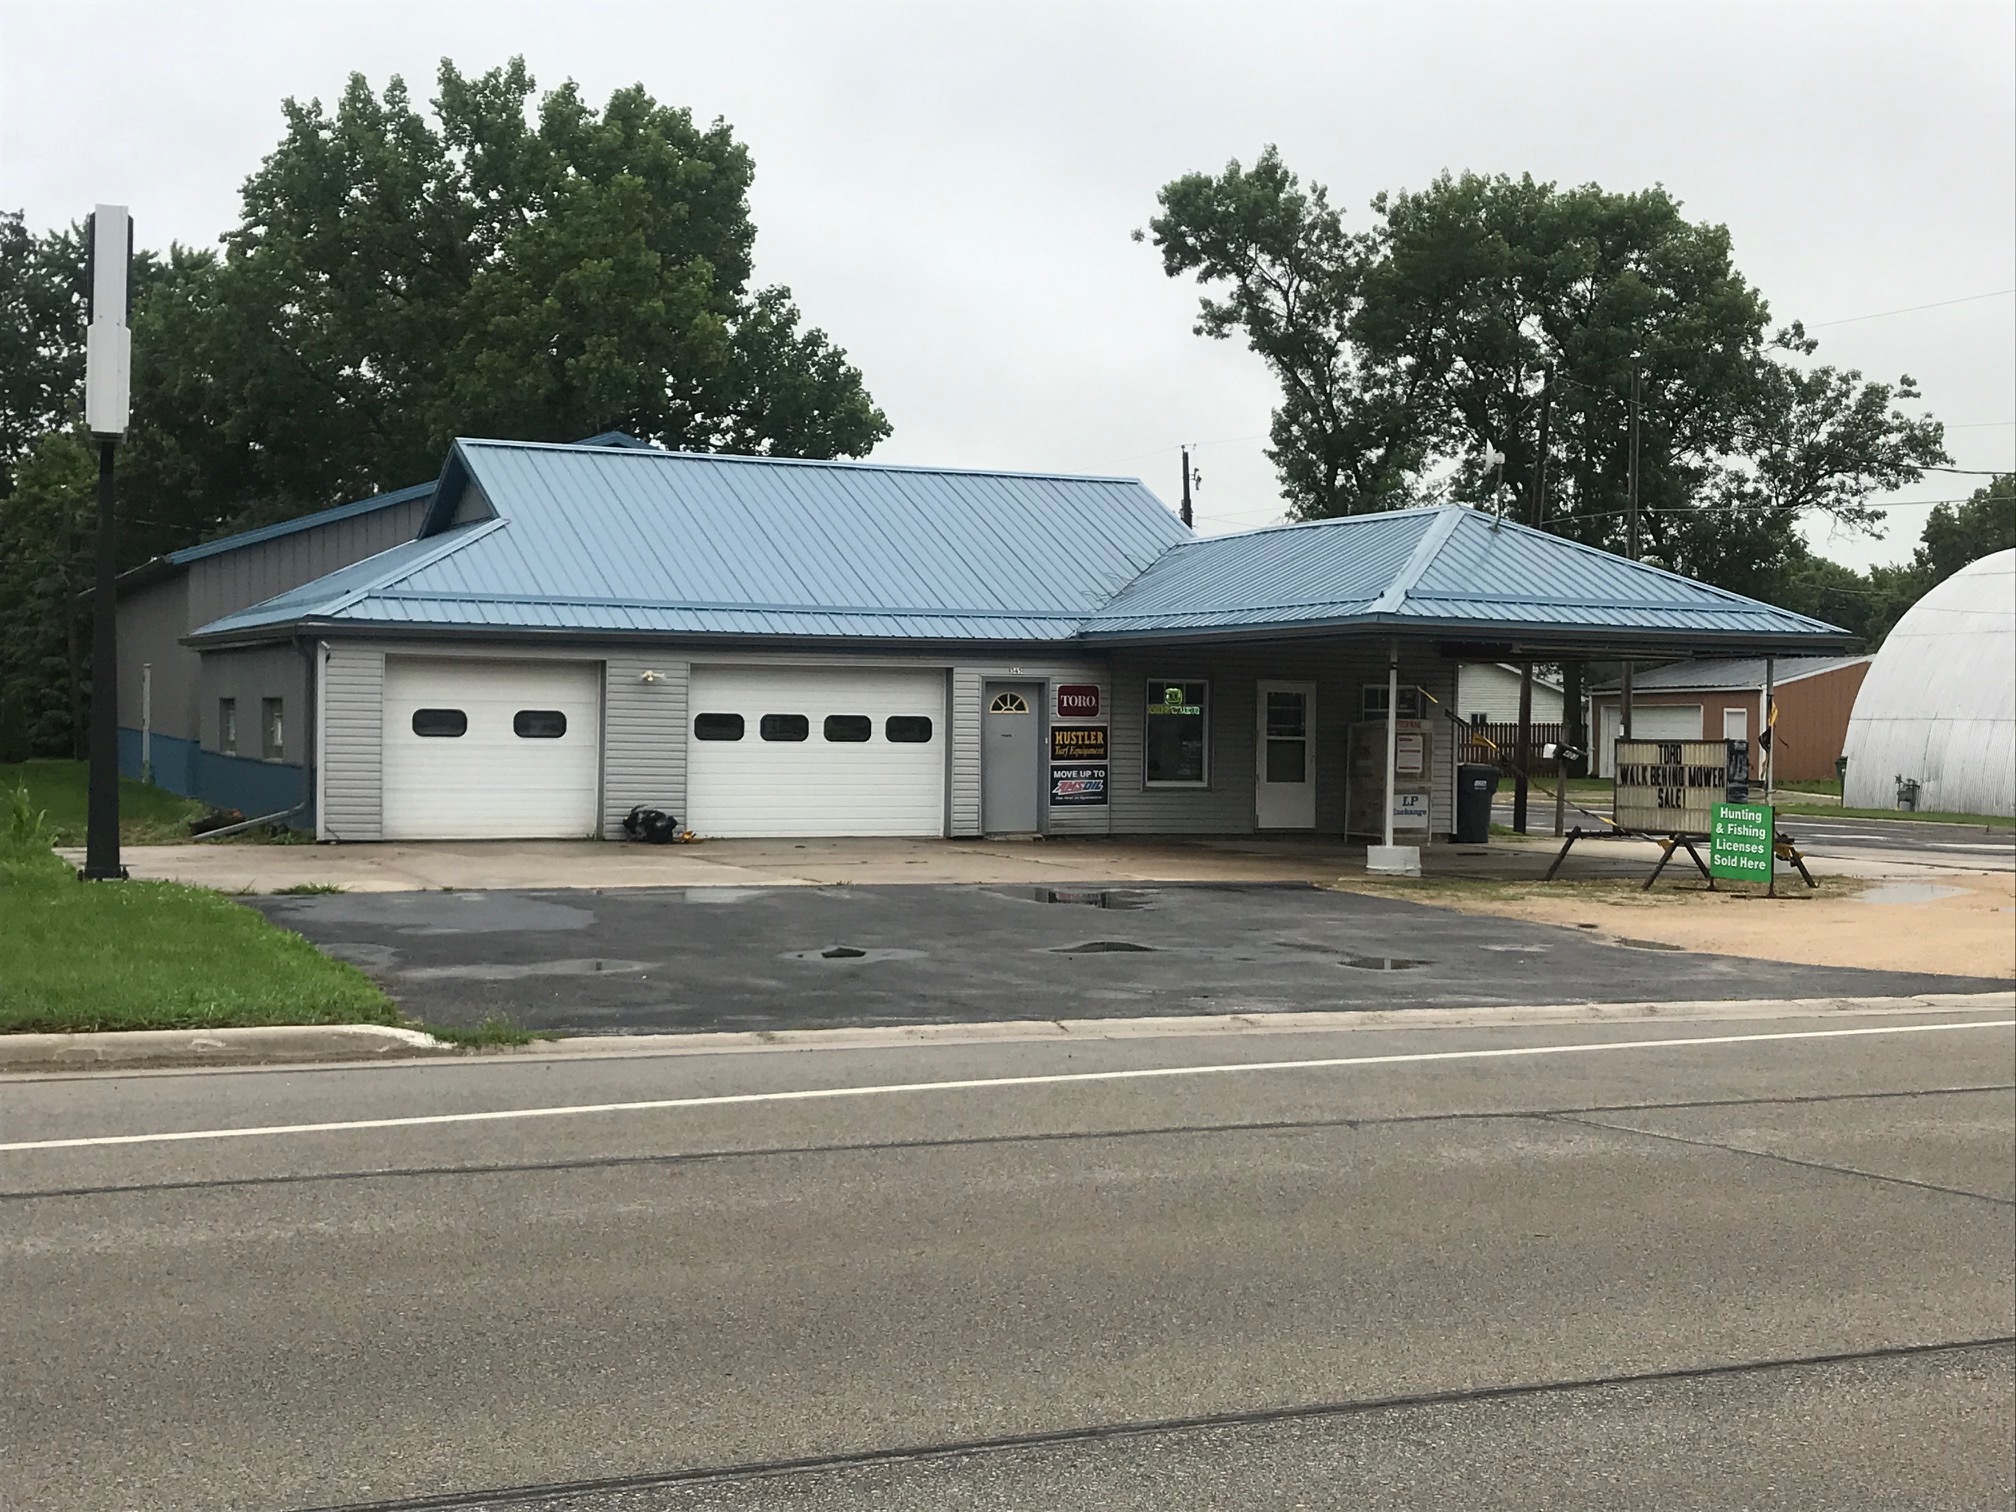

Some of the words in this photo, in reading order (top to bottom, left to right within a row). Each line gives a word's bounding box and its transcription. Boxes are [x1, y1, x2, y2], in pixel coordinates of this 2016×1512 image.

[1060, 695, 1096, 707] TORO
[1055, 731, 1104, 744] HUSTLER
[1055, 746, 1069, 757] Turf
[1069, 746, 1104, 757] Equipment
[1658, 744, 1682, 765] TORO
[1080, 770, 1091, 778] UP
[1620, 765, 1648, 786] WALK
[1650, 766, 1684, 786] BEHIND
[1688, 766, 1725, 787] MOWER
[1055, 780, 1103, 793] AMSOIL
[1402, 796, 1419, 806] LP
[1657, 788, 1686, 809] SALE!
[1720, 807, 1762, 823] Hunting
[1715, 823, 1724, 834] &
[1727, 823, 1766, 839] Fishing
[1716, 838, 1765, 853] Licenses
[1714, 854, 1738, 867] Sold
[1740, 856, 1766, 870] Here
